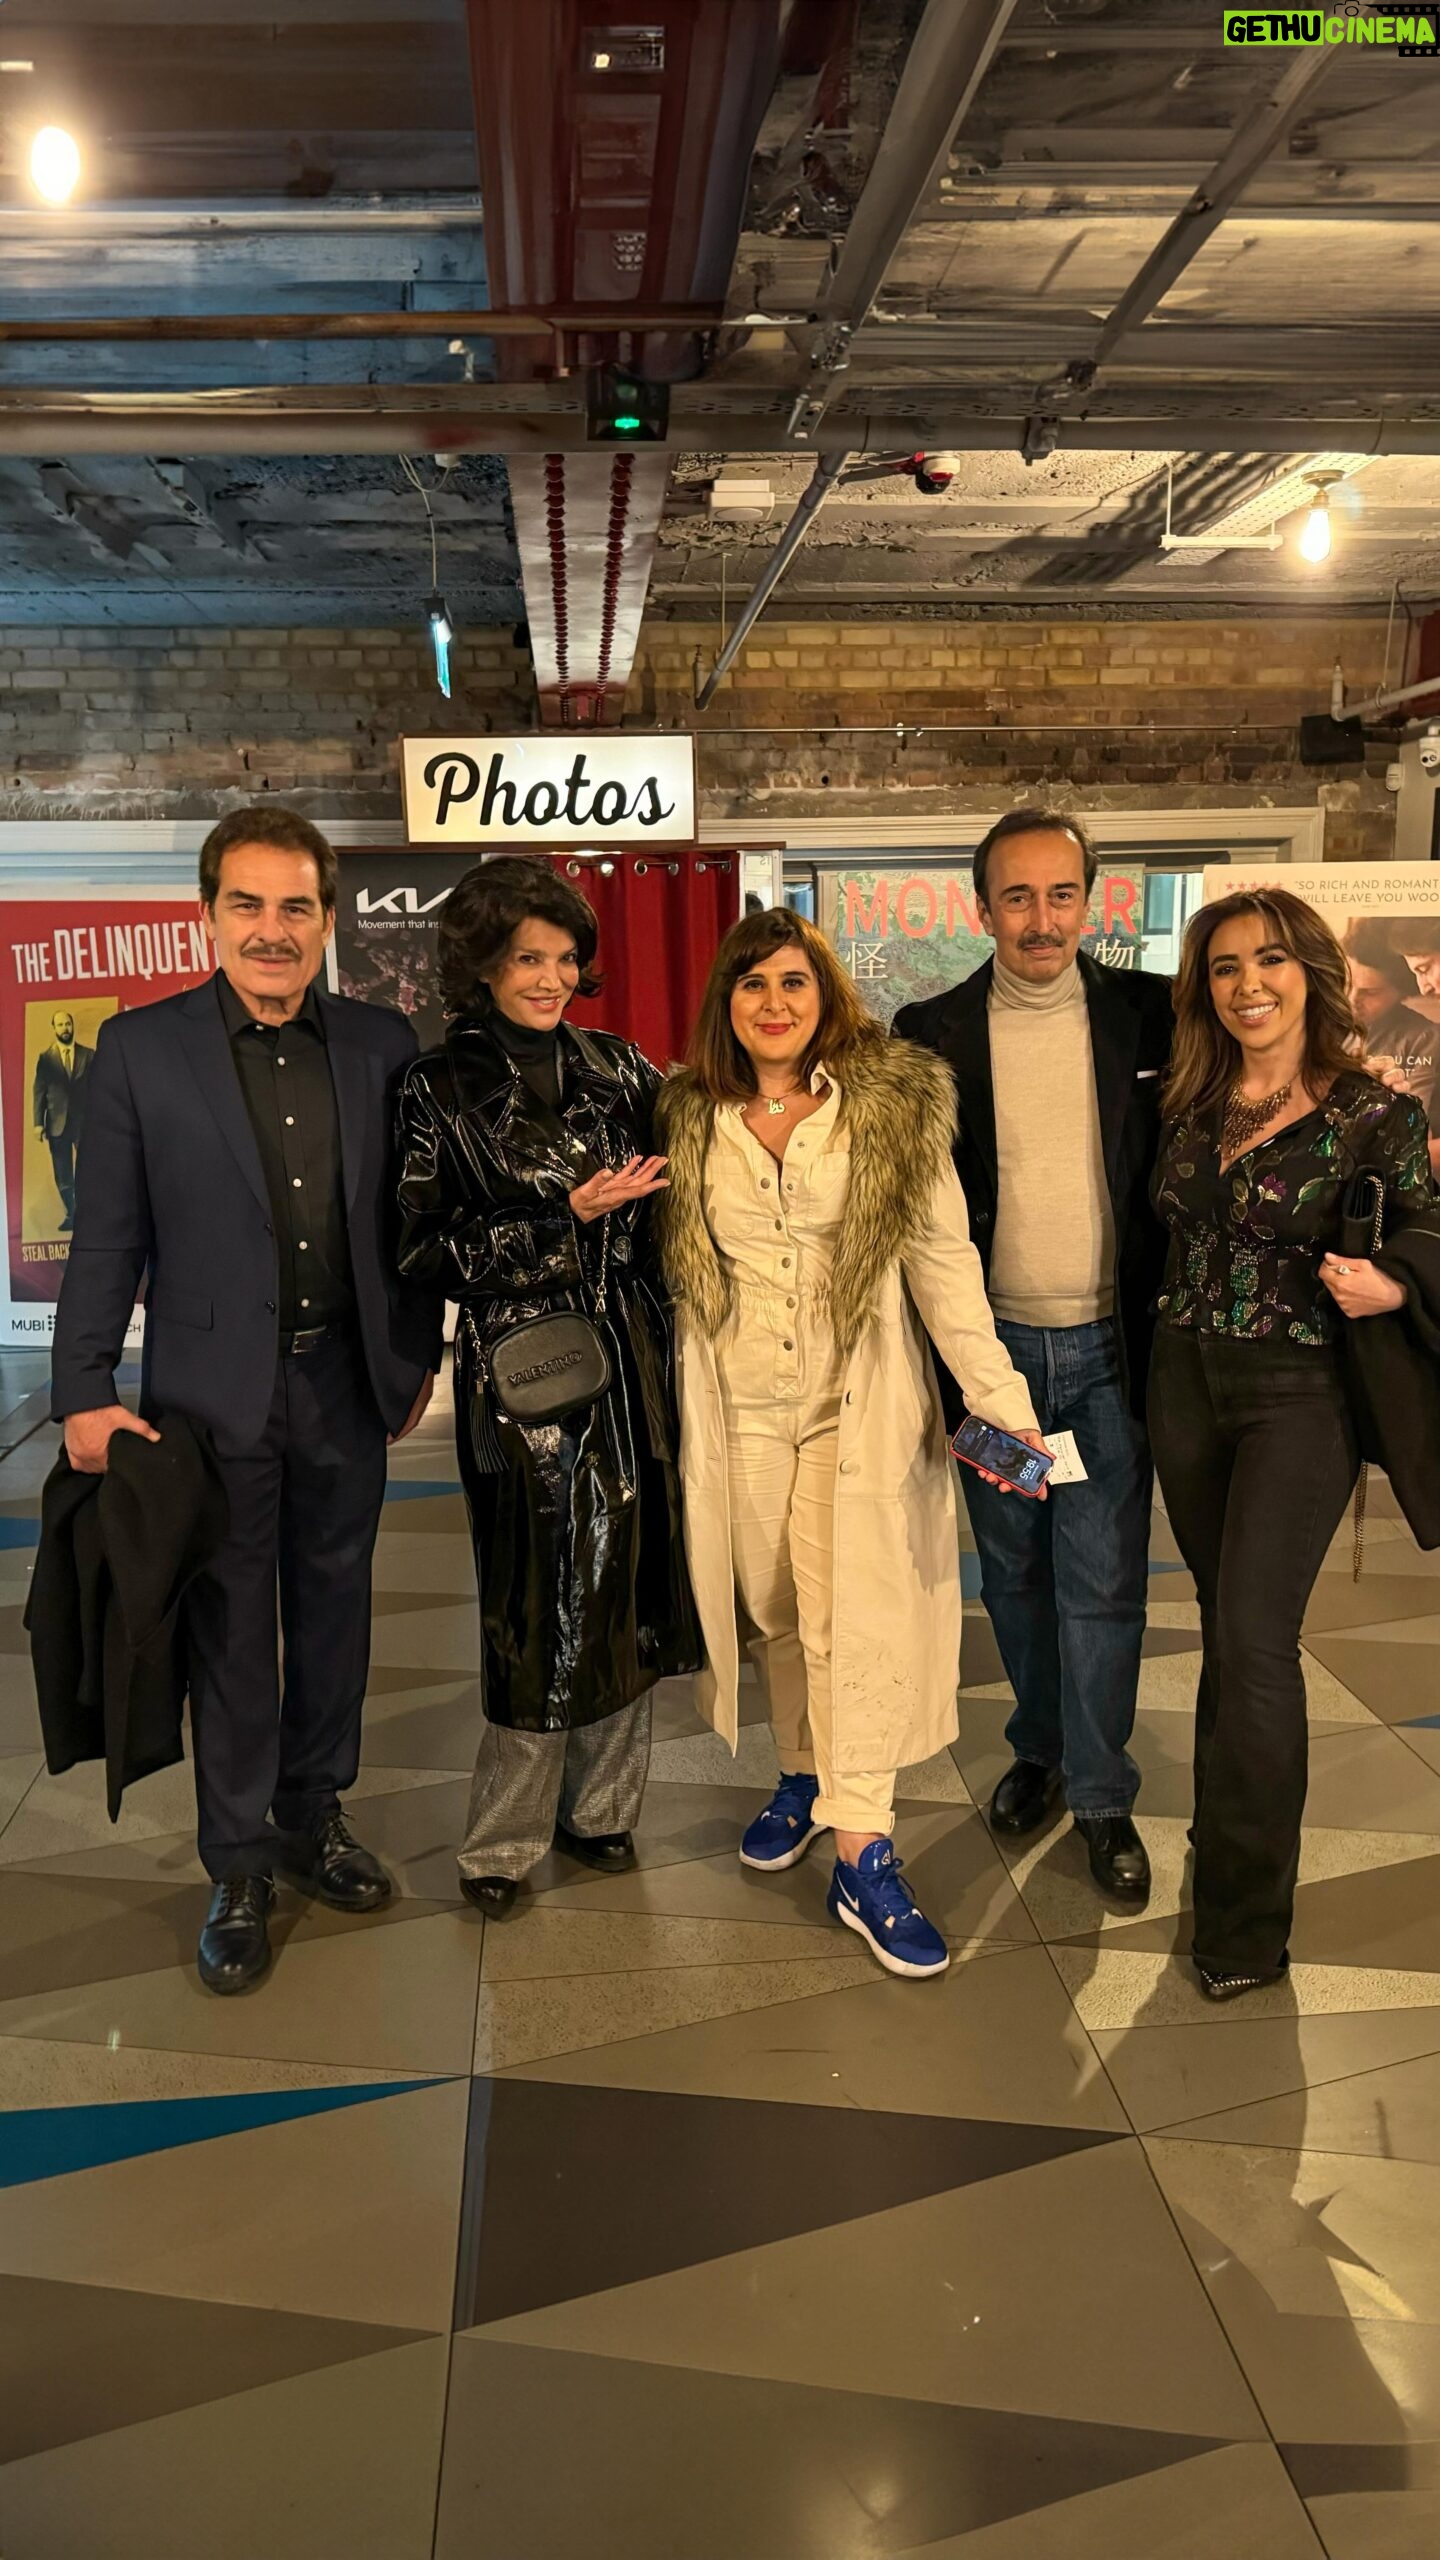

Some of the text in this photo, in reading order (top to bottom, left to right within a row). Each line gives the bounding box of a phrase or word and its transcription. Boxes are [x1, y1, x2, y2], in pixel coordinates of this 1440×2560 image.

[424, 752, 675, 826] Photos
[1319, 880, 1348, 890] RICH
[1353, 880, 1380, 889] AND
[1333, 893, 1372, 903] LEAVE
[1376, 892, 1403, 902] YOU
[846, 877, 1137, 939] MONR
[358, 920, 405, 929] Movement
[408, 920, 426, 929] that
[11, 943, 52, 983] THE
[1406, 1056, 1432, 1065] CAN
[22, 1245, 48, 1262] STEAL
[11, 1320, 44, 1331] MUBI
[508, 1352, 582, 1385] VALENTINO
[1020, 1459, 1037, 1480] 19:55
